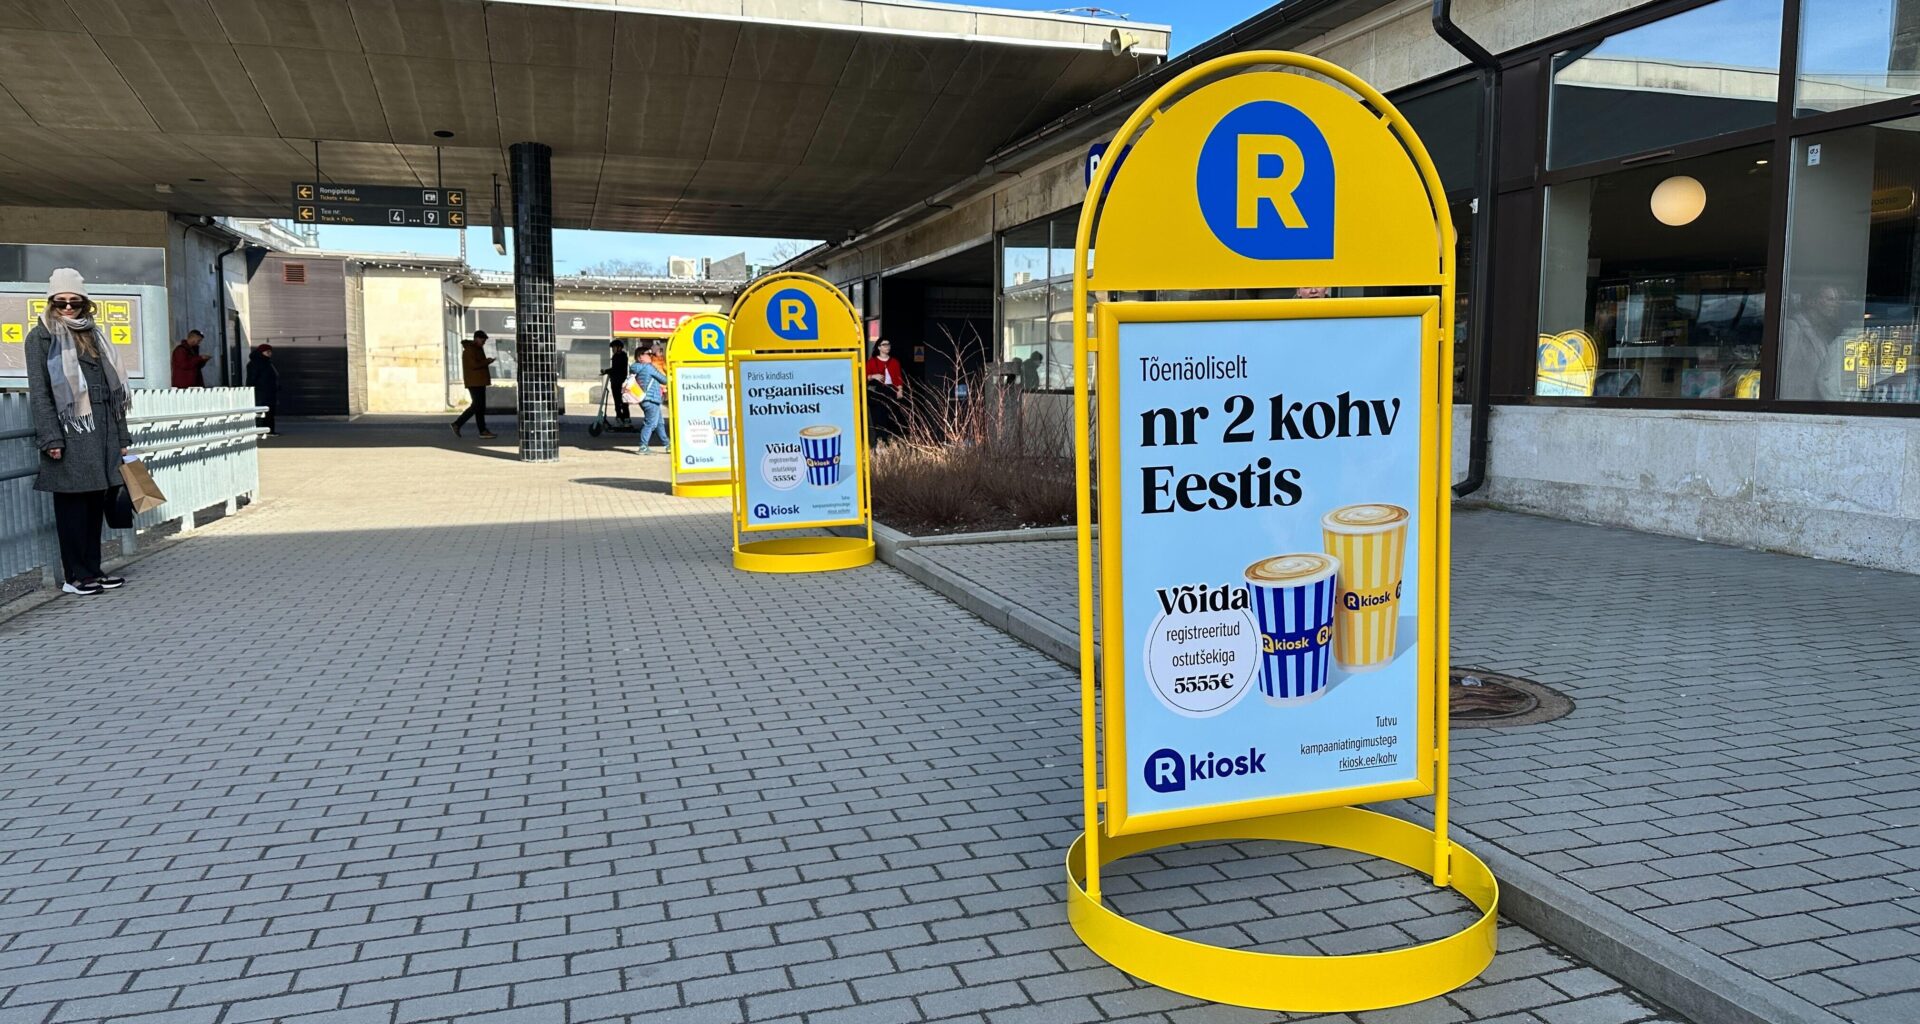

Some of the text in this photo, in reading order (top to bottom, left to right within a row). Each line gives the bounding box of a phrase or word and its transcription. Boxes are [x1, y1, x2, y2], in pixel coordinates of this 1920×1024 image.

[1236, 133, 1309, 229] R
[393, 211, 401, 222] 4
[427, 212, 435, 223] 9
[630, 316, 676, 329] CIRCLE
[780, 299, 808, 331] R
[701, 328, 719, 350] R
[747, 371, 794, 381] Päris kindlasti
[1140, 354, 1248, 382] Tõenäoliselt
[683, 393, 724, 403] hinnaga
[748, 383, 845, 400] orgaanilisest
[749, 401, 821, 416] kohvioast
[1140, 390, 1401, 448] nr 2 kohv
[765, 442, 801, 454] Võida
[1140, 456, 1303, 515] Eestis
[771, 504, 800, 516] kiosk
[1156, 583, 1249, 616] Võida
[1361, 591, 1391, 607] kiosk
[1166, 621, 1241, 645] registreeritud
[1275, 636, 1309, 650] kiosk
[1172, 648, 1236, 668] ostutšekiga
[1174, 672, 1235, 695] 5555€
[1375, 715, 1398, 728] Tutvu
[1300, 733, 1398, 757] kampaaniatingimustega
[1190, 747, 1266, 782] kiosk
[1338, 751, 1398, 770] rkiosk.ee/kohv
